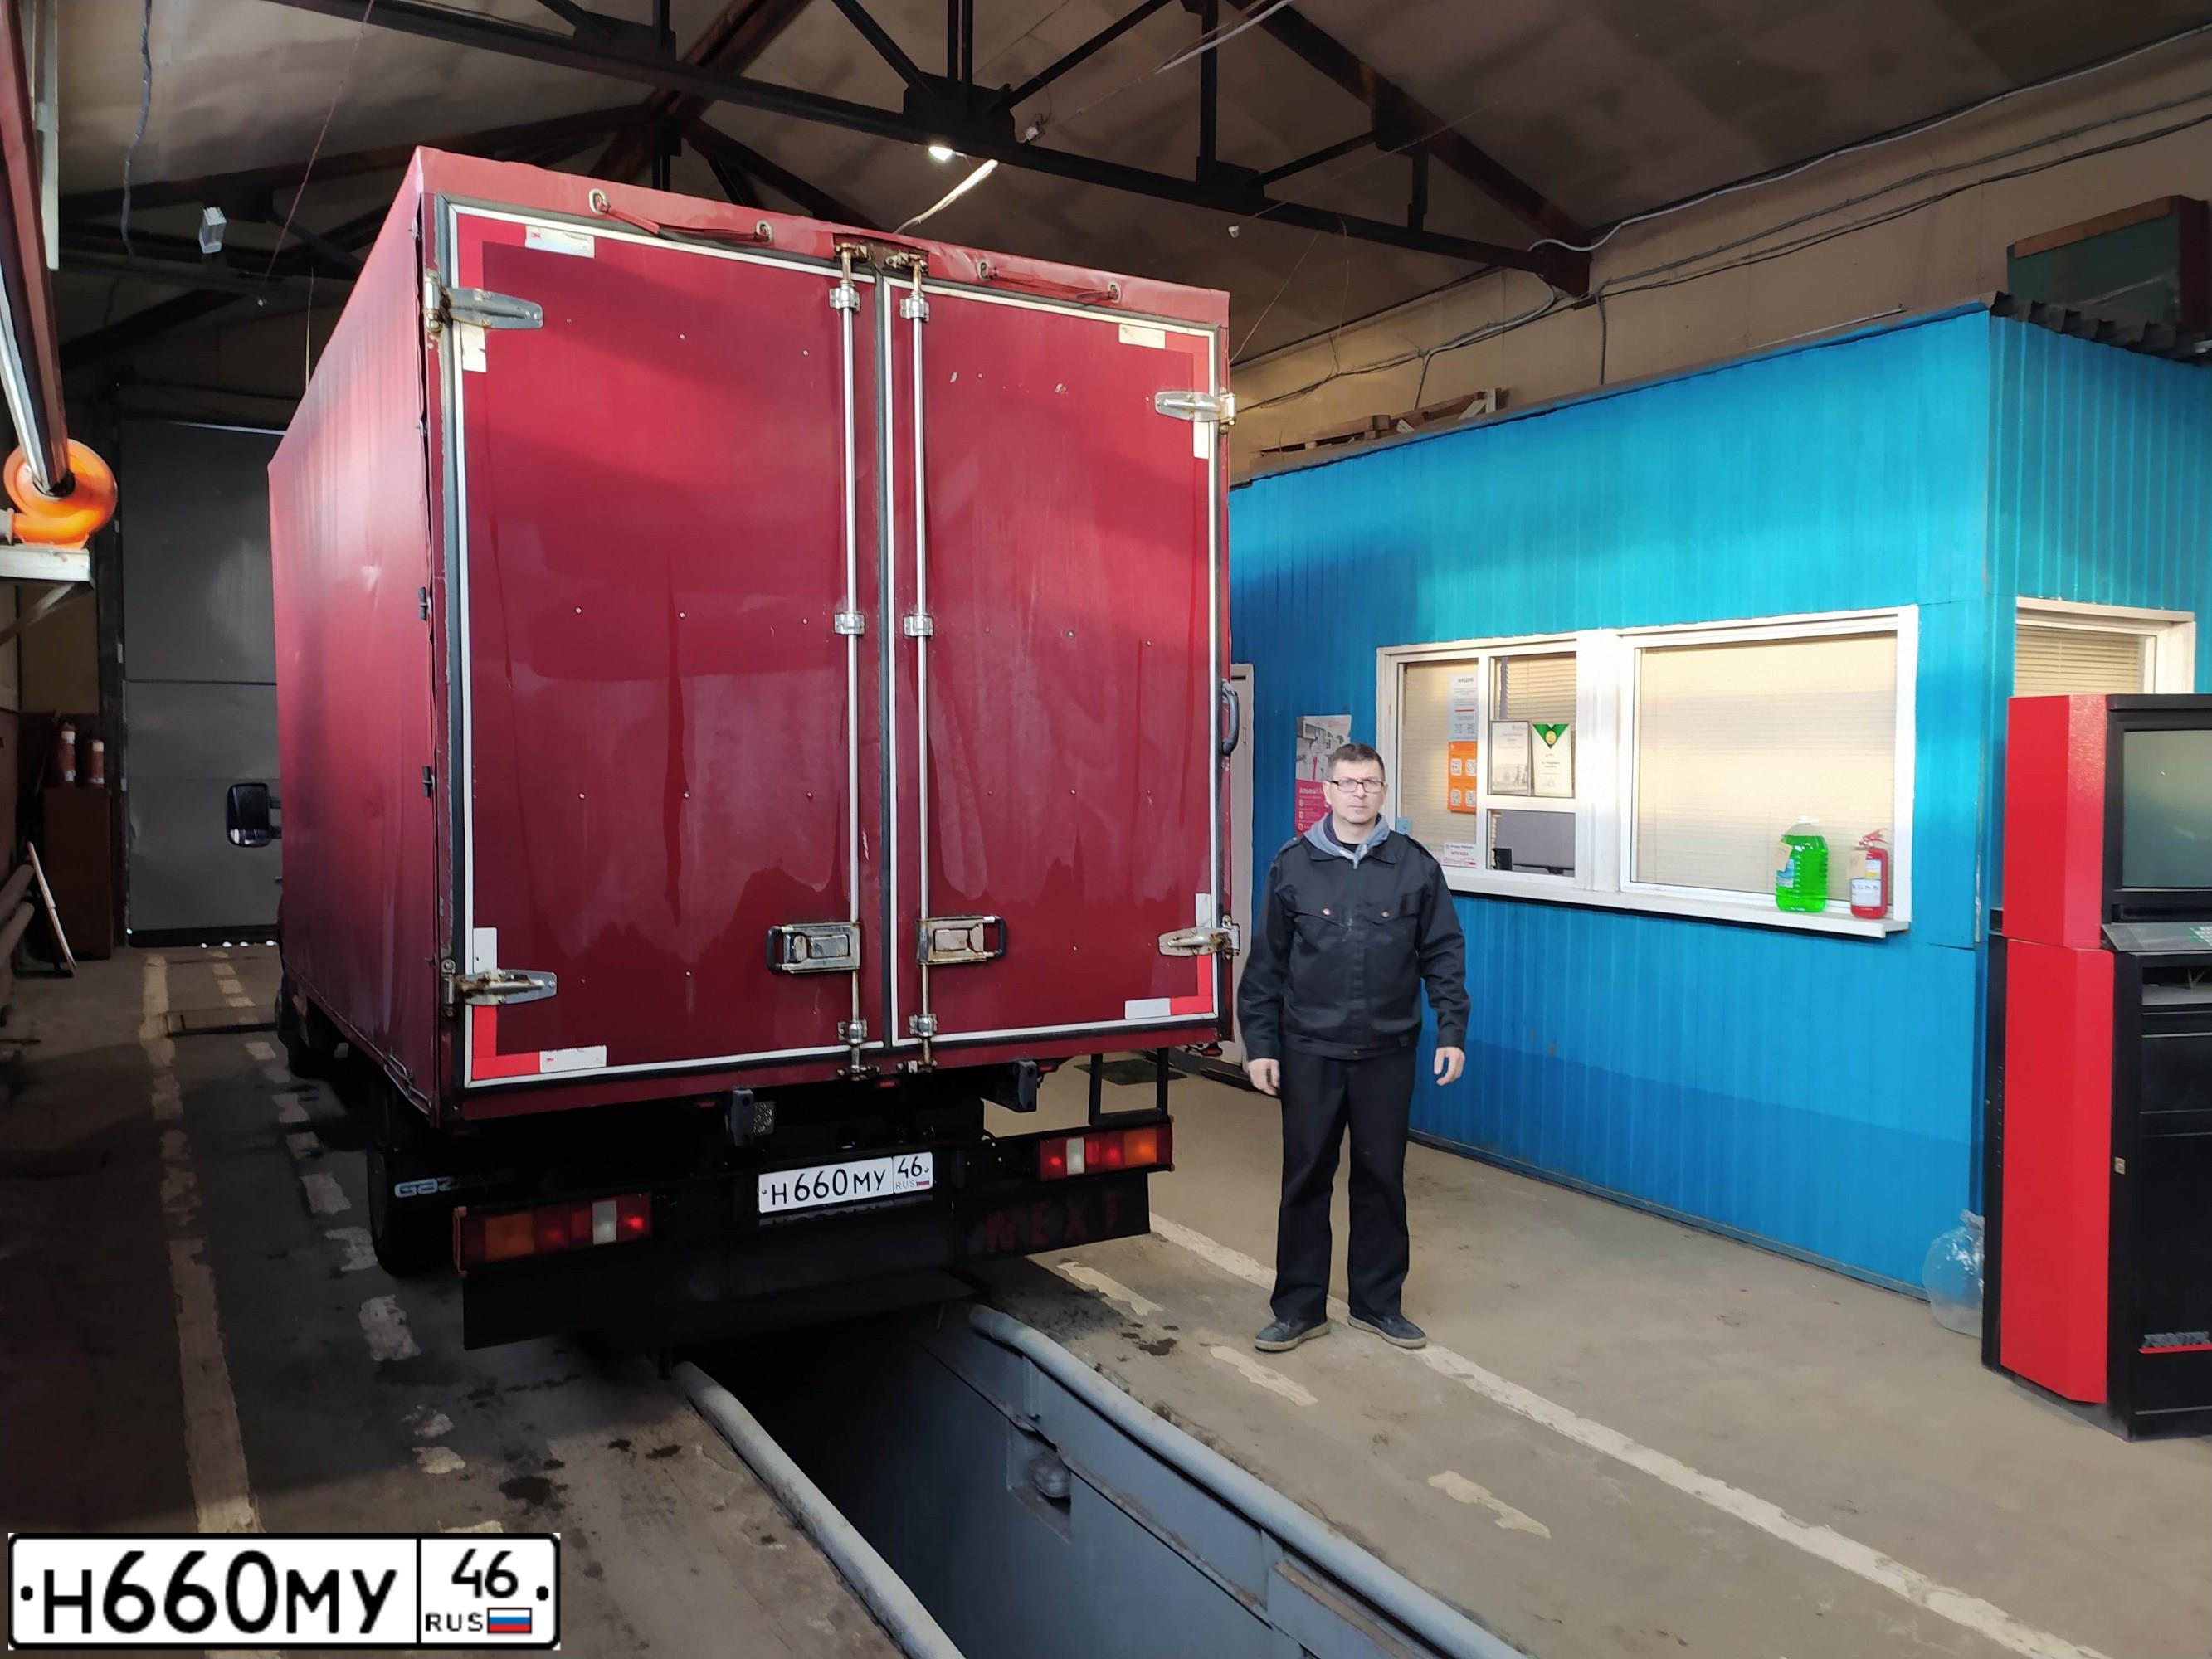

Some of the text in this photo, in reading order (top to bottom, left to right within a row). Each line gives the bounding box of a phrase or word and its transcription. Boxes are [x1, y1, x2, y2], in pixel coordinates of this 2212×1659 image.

[772, 1155, 923, 1205] Н660МУ 46
[895, 1180, 915, 1190] RUS
